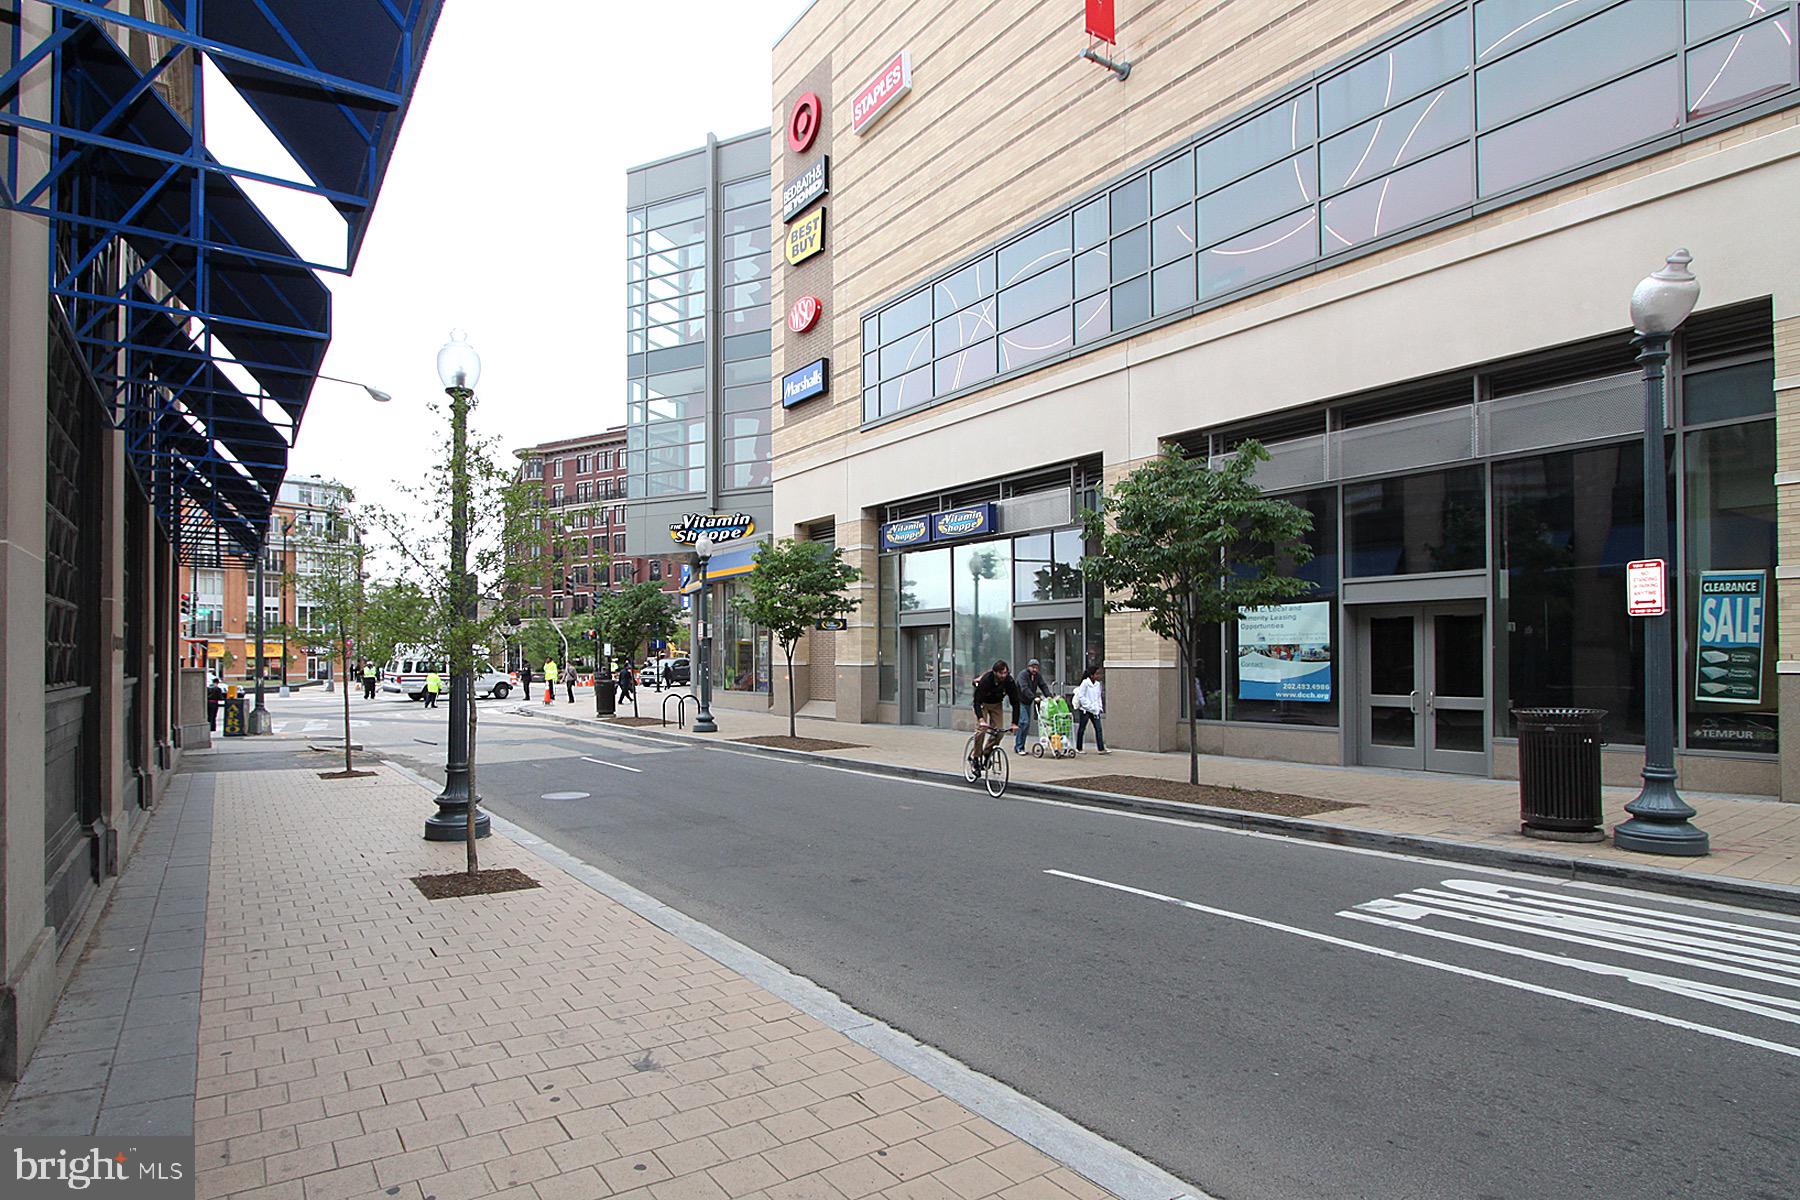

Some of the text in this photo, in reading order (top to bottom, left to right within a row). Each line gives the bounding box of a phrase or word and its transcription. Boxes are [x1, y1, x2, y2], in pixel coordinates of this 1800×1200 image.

[853, 63, 902, 121] STAPLES
[783, 178, 823, 216] BEYOND
[790, 215, 820, 245] BEST
[791, 233, 816, 259] BUY
[784, 369, 822, 399] Marshalls
[682, 512, 751, 529] Vitamin
[943, 510, 982, 524] Vitamin
[890, 520, 925, 532] Vitamin
[942, 521, 978, 534] Shoppe
[891, 531, 920, 543] Shoppe
[1703, 582, 1757, 592] CLEARANCE
[1701, 597, 1761, 643] SALE
[1702, 729, 1754, 739] TEMPUR
